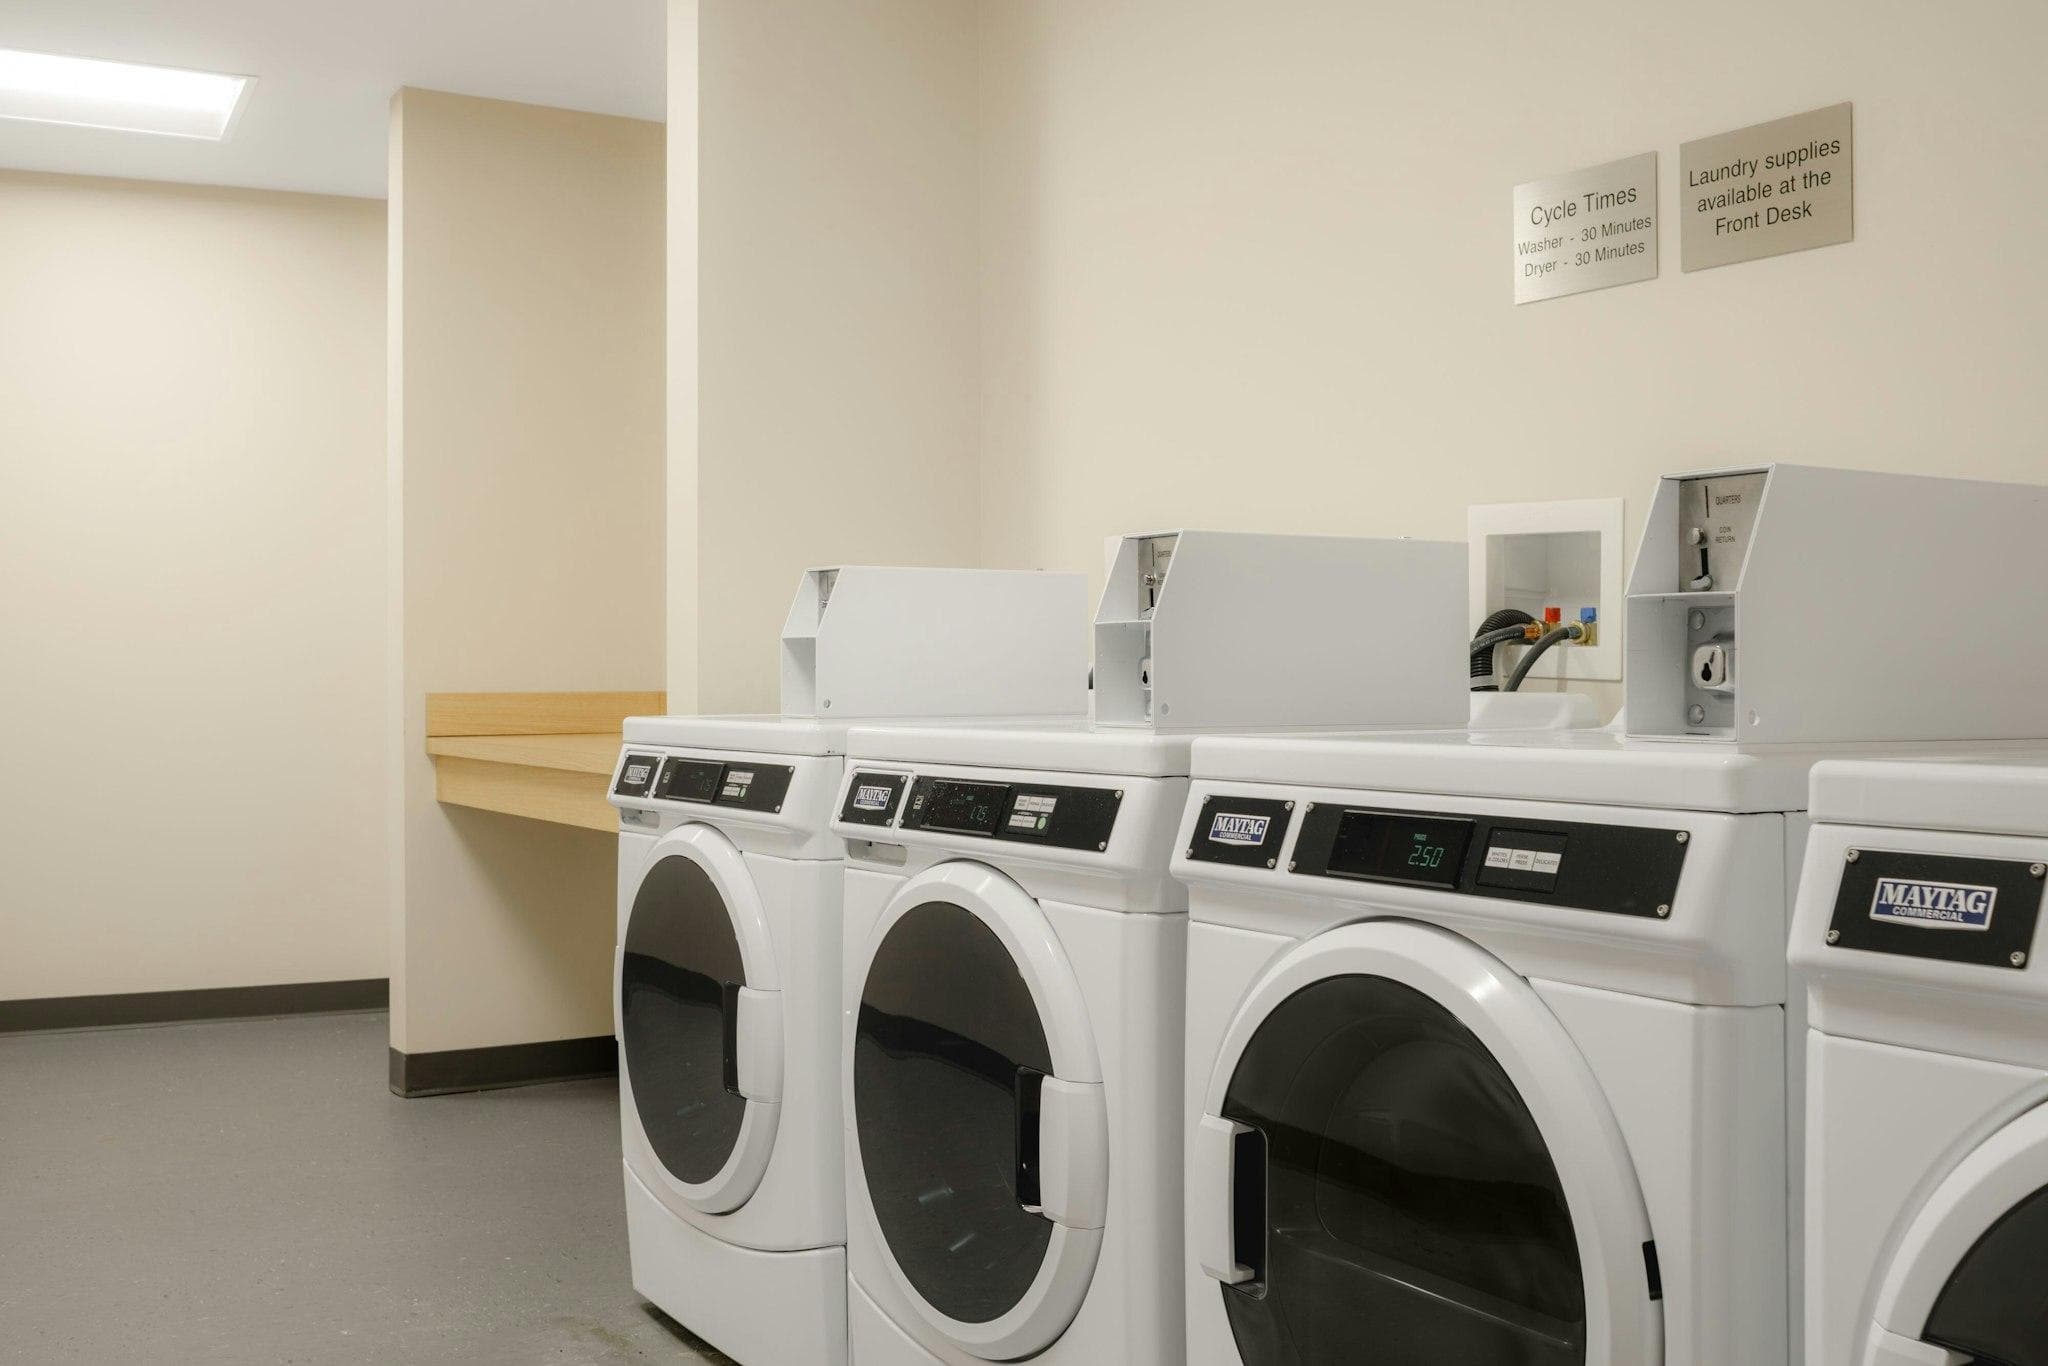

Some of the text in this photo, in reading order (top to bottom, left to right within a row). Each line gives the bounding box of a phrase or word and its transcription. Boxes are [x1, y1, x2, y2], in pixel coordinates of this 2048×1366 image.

[1689, 139, 1841, 187] Laundry supplies
[1530, 187, 1637, 228] Cycle Times
[1697, 170, 1831, 213] available at the
[1518, 236, 1563, 256] Washer
[1581, 226, 1597, 242] 30
[1601, 216, 1652, 238] Minutes
[1715, 200, 1813, 236] Front Desk
[1524, 259, 1558, 278] Dryer
[1575, 251, 1591, 267] 30
[1595, 241, 1645, 262] Minutes
[857, 788, 889, 801] MAYTAG
[1214, 816, 1265, 835] MAYTAG
[1408, 844, 1444, 867] 2.50
[1878, 882, 1988, 914] MAYTAG
[1892, 906, 1964, 922] COMMERCIAL
